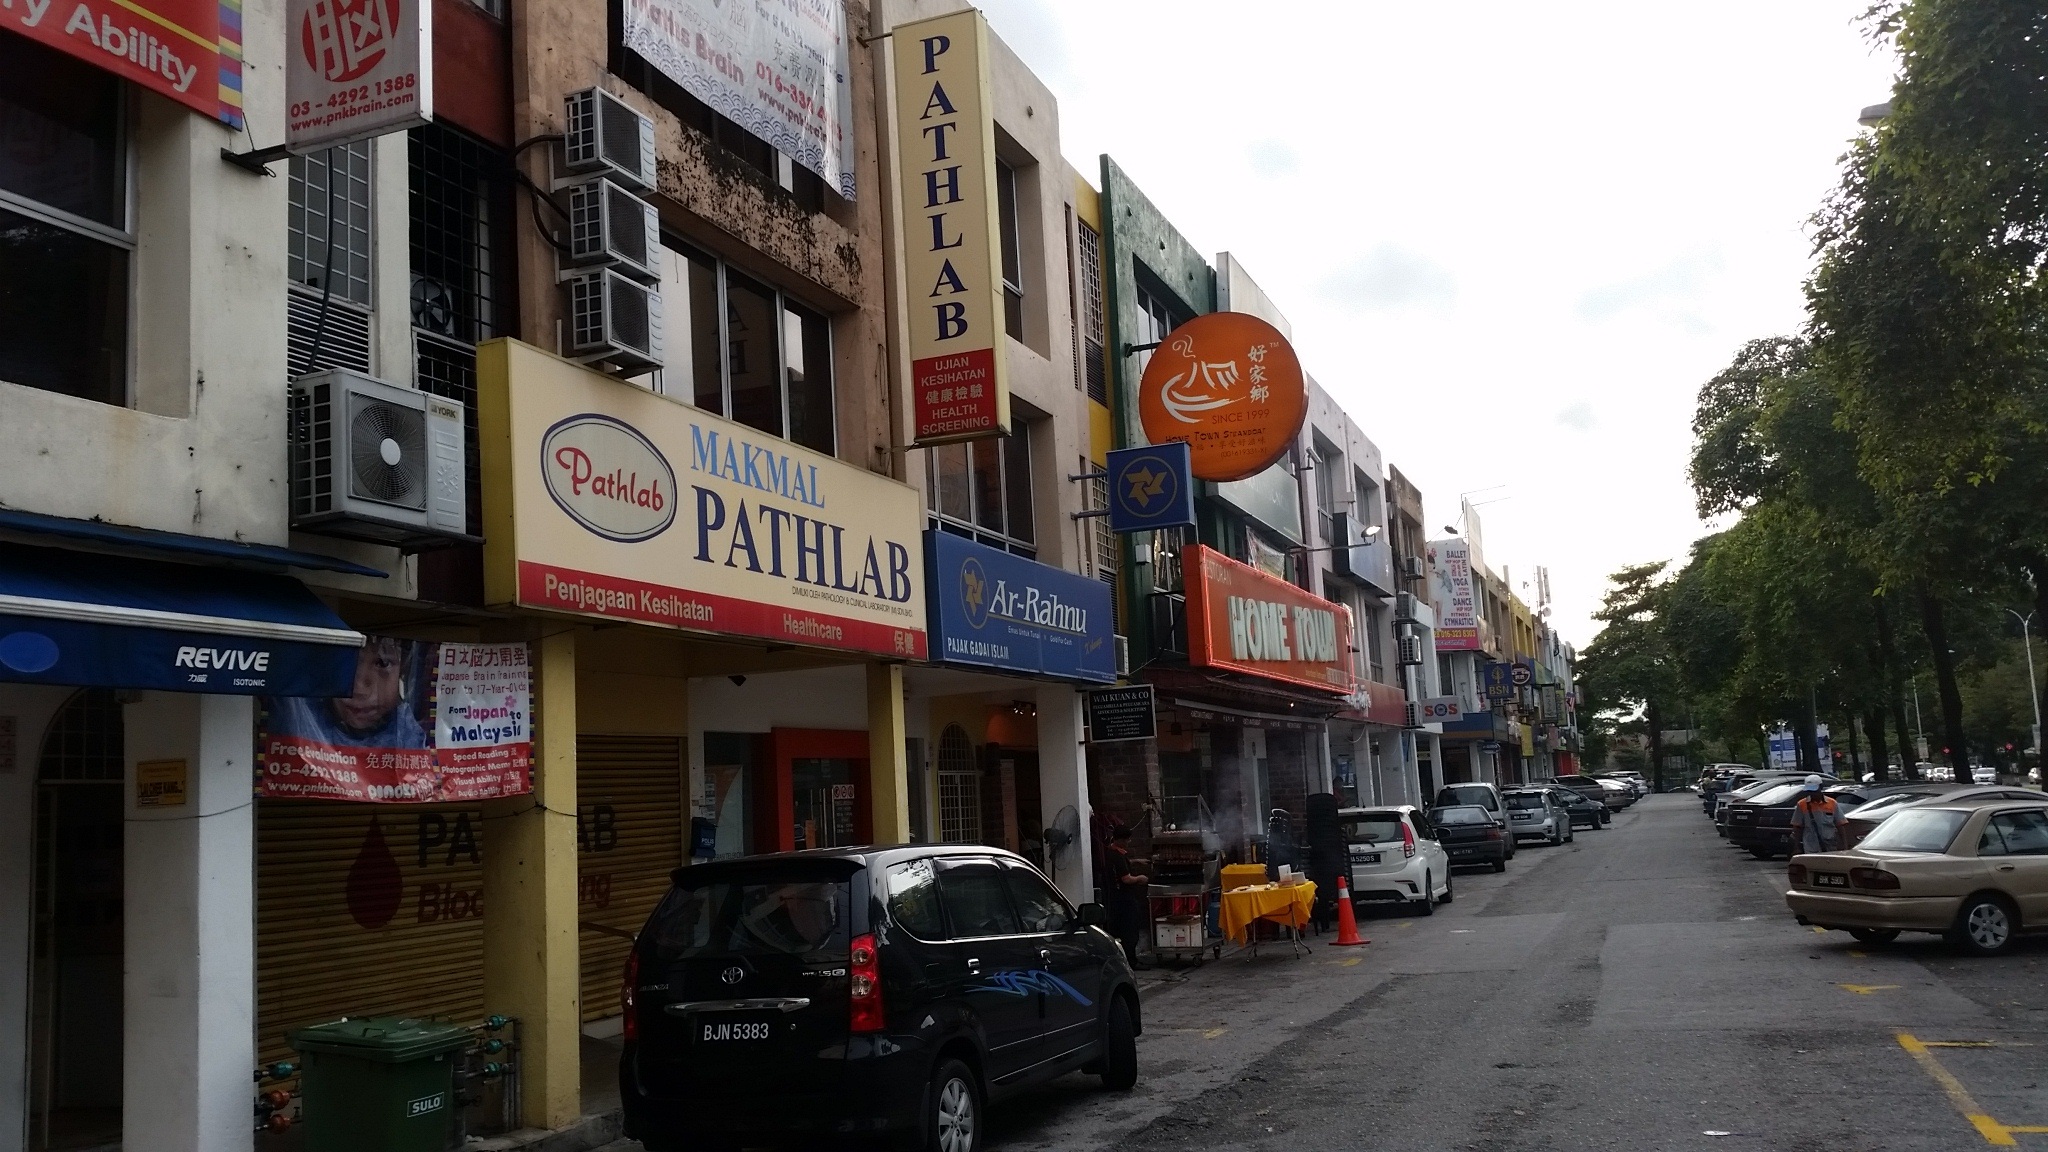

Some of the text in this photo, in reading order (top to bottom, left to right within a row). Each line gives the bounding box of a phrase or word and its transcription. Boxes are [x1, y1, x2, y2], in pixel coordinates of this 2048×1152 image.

[65, 3, 197, 93] Ability
[696, 32, 744, 86] Brain
[291, 101, 310, 118] 03
[327, 85, 369, 108] 4292
[375, 73, 415, 96] 1388
[291, 93, 414, 132] www.pnkbrain.com
[919, 35, 969, 342] PATHLAB
[936, 356, 969, 370] UJIAN
[922, 368, 986, 387] KESIHATAN
[1248, 344, 1269, 404] 好家鄉
[926, 384, 984, 404] 健康檢驗
[437, 406, 456, 418] YORK
[932, 404, 977, 420] HEALTH
[1212, 409, 1270, 425] SINCE 1999
[922, 416, 990, 434] SCREENING
[1194, 432, 1220, 441] TOWN
[690, 424, 825, 509] MAKMAL
[556, 446, 664, 512] Pathlab
[691, 484, 912, 603] PATHLAB
[545, 573, 714, 622] Penjagaan Kesihatan
[989, 579, 1087, 634] Ar-Rahnu
[1453, 598, 1472, 606] DANCE
[782, 613, 843, 642] Healthcare
[1228, 595, 1338, 662] HOME TOWN
[1444, 618, 1474, 626] GYMNASTICS
[947, 637, 1009, 660] PAJAK GADAI ISLAM
[175, 646, 270, 671] REVIVE
[474, 671, 495, 680] Brain
[441, 684, 456, 694] For
[1093, 694, 1108, 702] WAI
[1110, 692, 1130, 701] KUAN
[1489, 685, 1509, 695] BSN
[464, 705, 508, 723] Japan
[510, 711, 521, 720] to
[1424, 703, 1458, 717] SOS
[270, 742, 357, 766] Free Evaluation
[453, 752, 476, 762] Speed
[478, 750, 509, 759] Reading
[441, 764, 486, 775] Photographic
[453, 774, 501, 786] Visual Ability
[704, 1023, 769, 1041] BJN 5383
[412, 1097, 440, 1113] SULO
